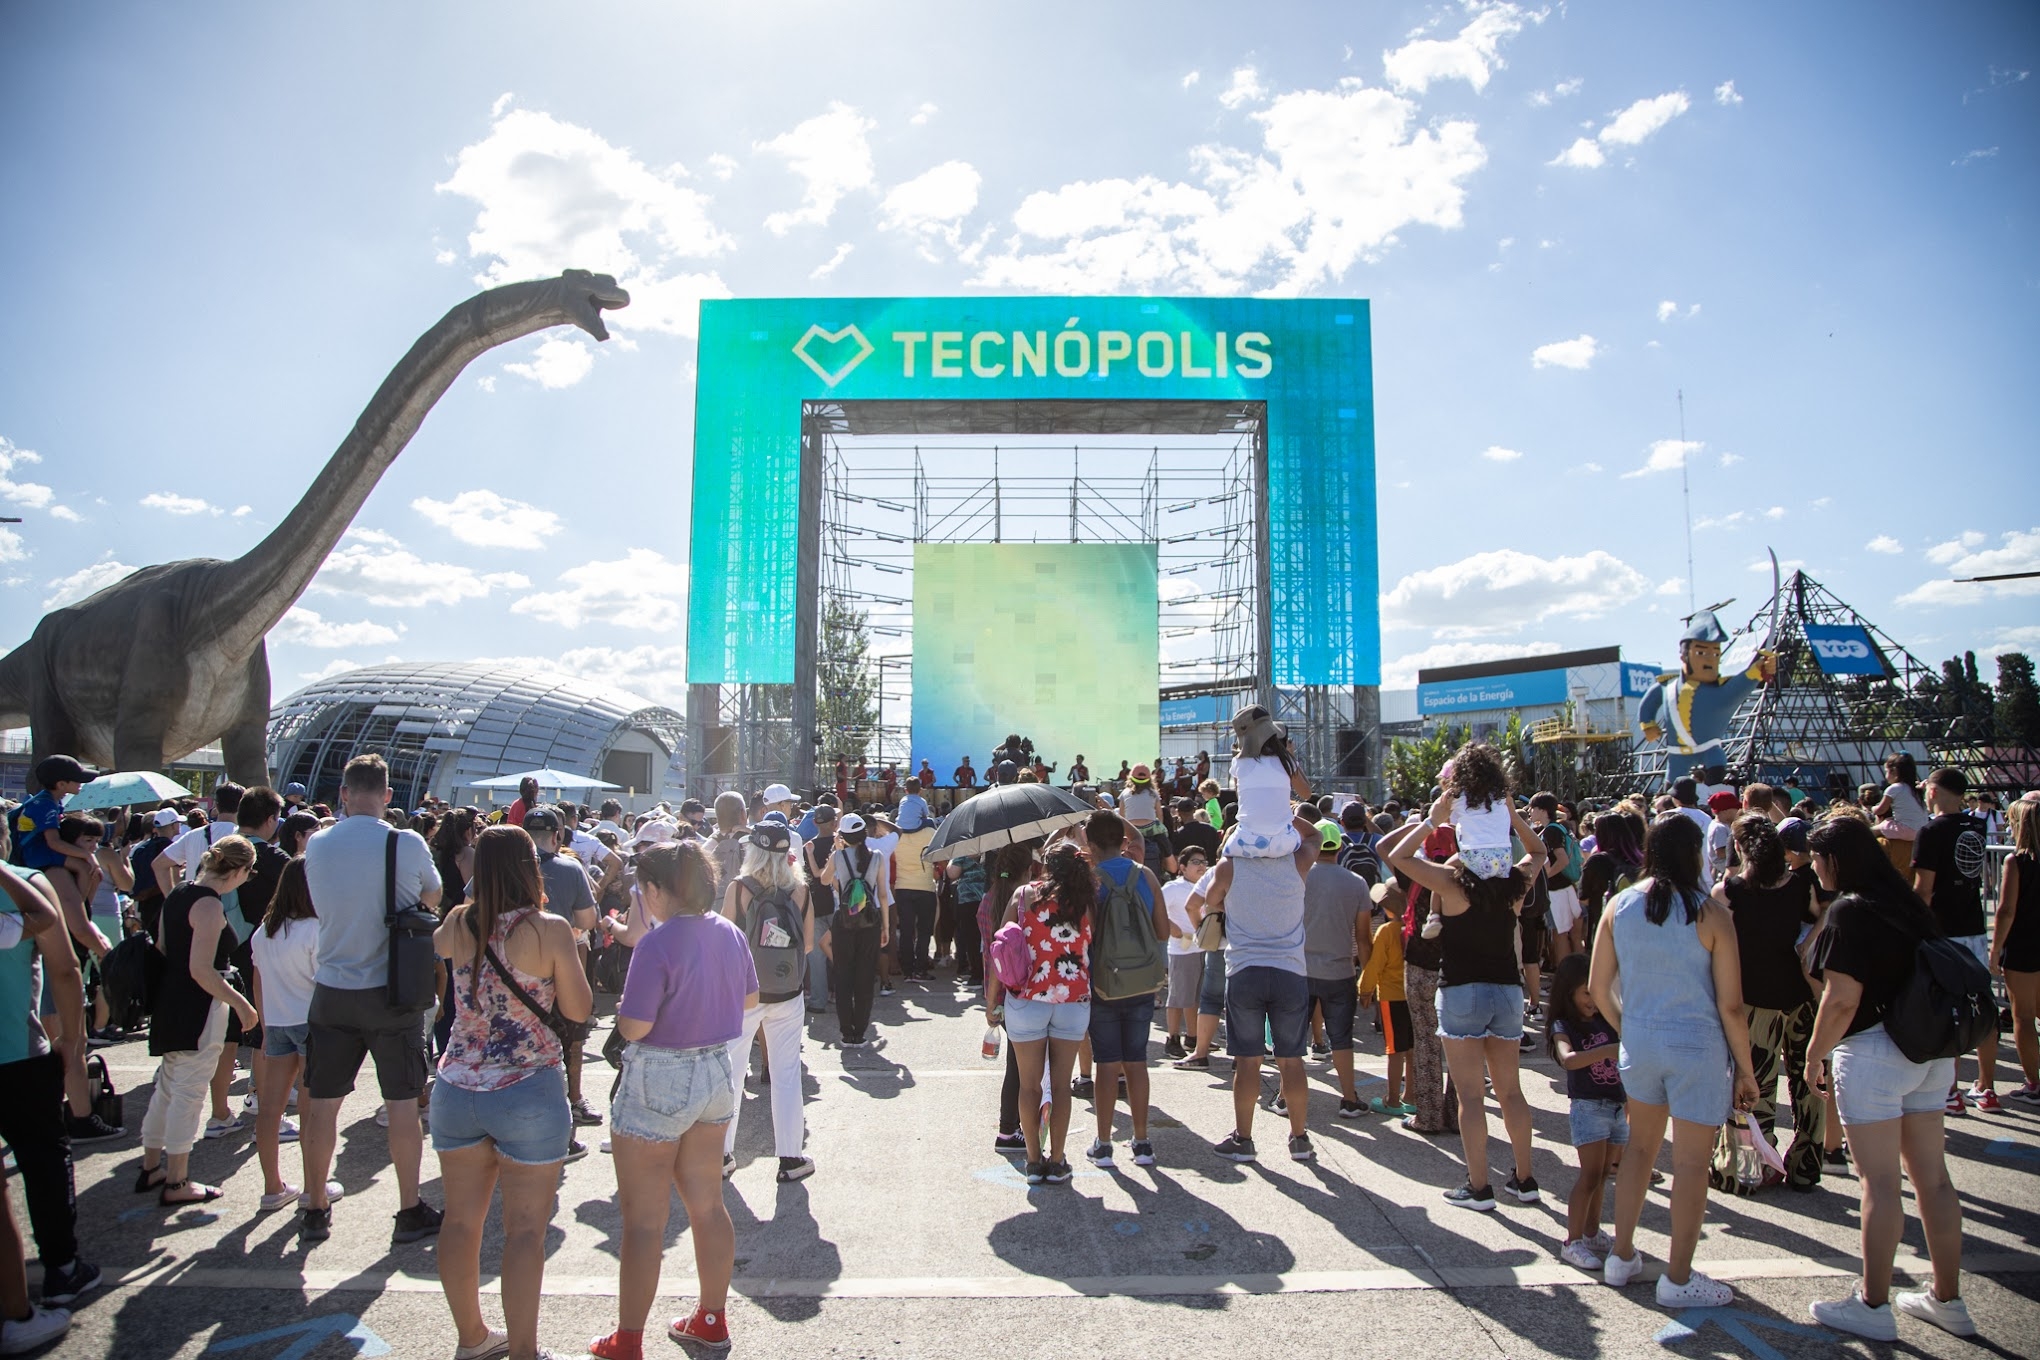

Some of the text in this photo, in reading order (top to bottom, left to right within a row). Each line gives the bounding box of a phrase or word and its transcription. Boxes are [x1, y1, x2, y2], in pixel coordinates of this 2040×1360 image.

[892, 317, 1273, 379] TECNÓPOLIS
[1424, 688, 1513, 707] Espacio de la Energía
[1165, 713, 1172, 721] la
[1172, 711, 1197, 721] Energía
